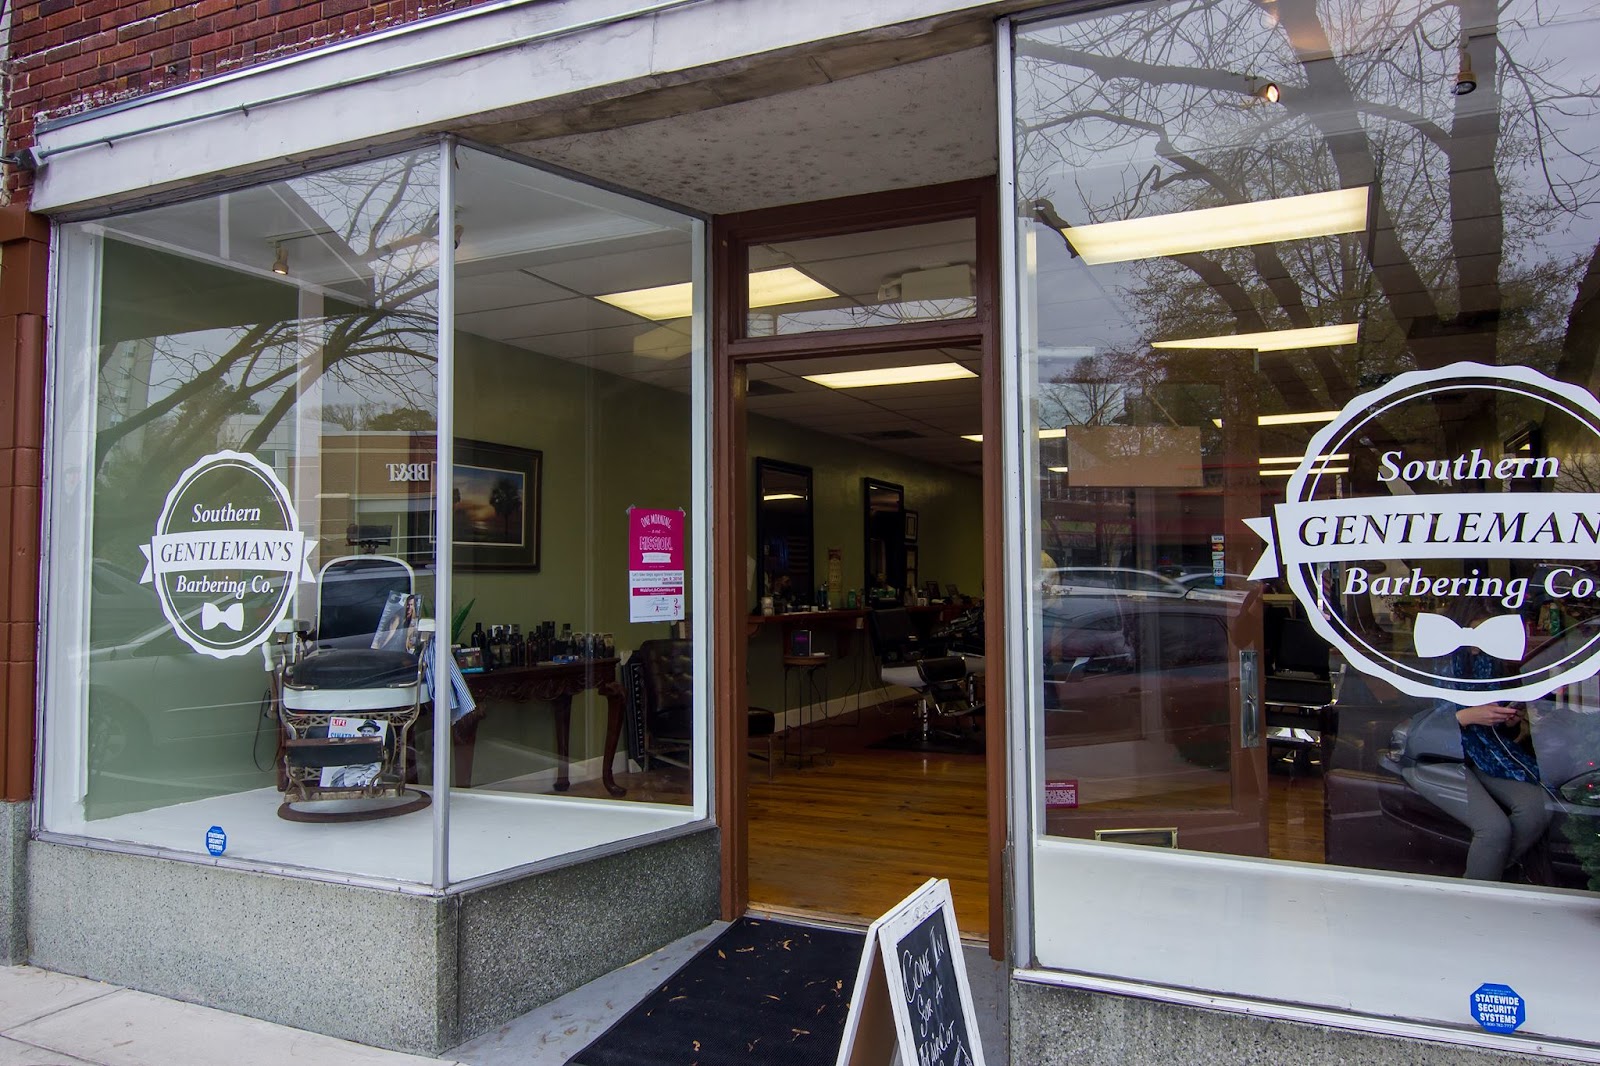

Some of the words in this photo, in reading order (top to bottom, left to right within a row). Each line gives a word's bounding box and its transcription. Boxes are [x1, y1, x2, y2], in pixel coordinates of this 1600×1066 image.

[1376, 448, 1560, 482] Southern
[191, 503, 261, 523] Southern
[161, 541, 293, 563] GENTLEMAN'S
[176, 575, 247, 599] Barbering
[251, 575, 275, 594] Co.
[1342, 567, 1529, 609] Barbering
[1475, 993, 1519, 1006] STATEWIDE
[1477, 1003, 1517, 1015] SECURITY
[1480, 1012, 1517, 1025] SYSTEMS
